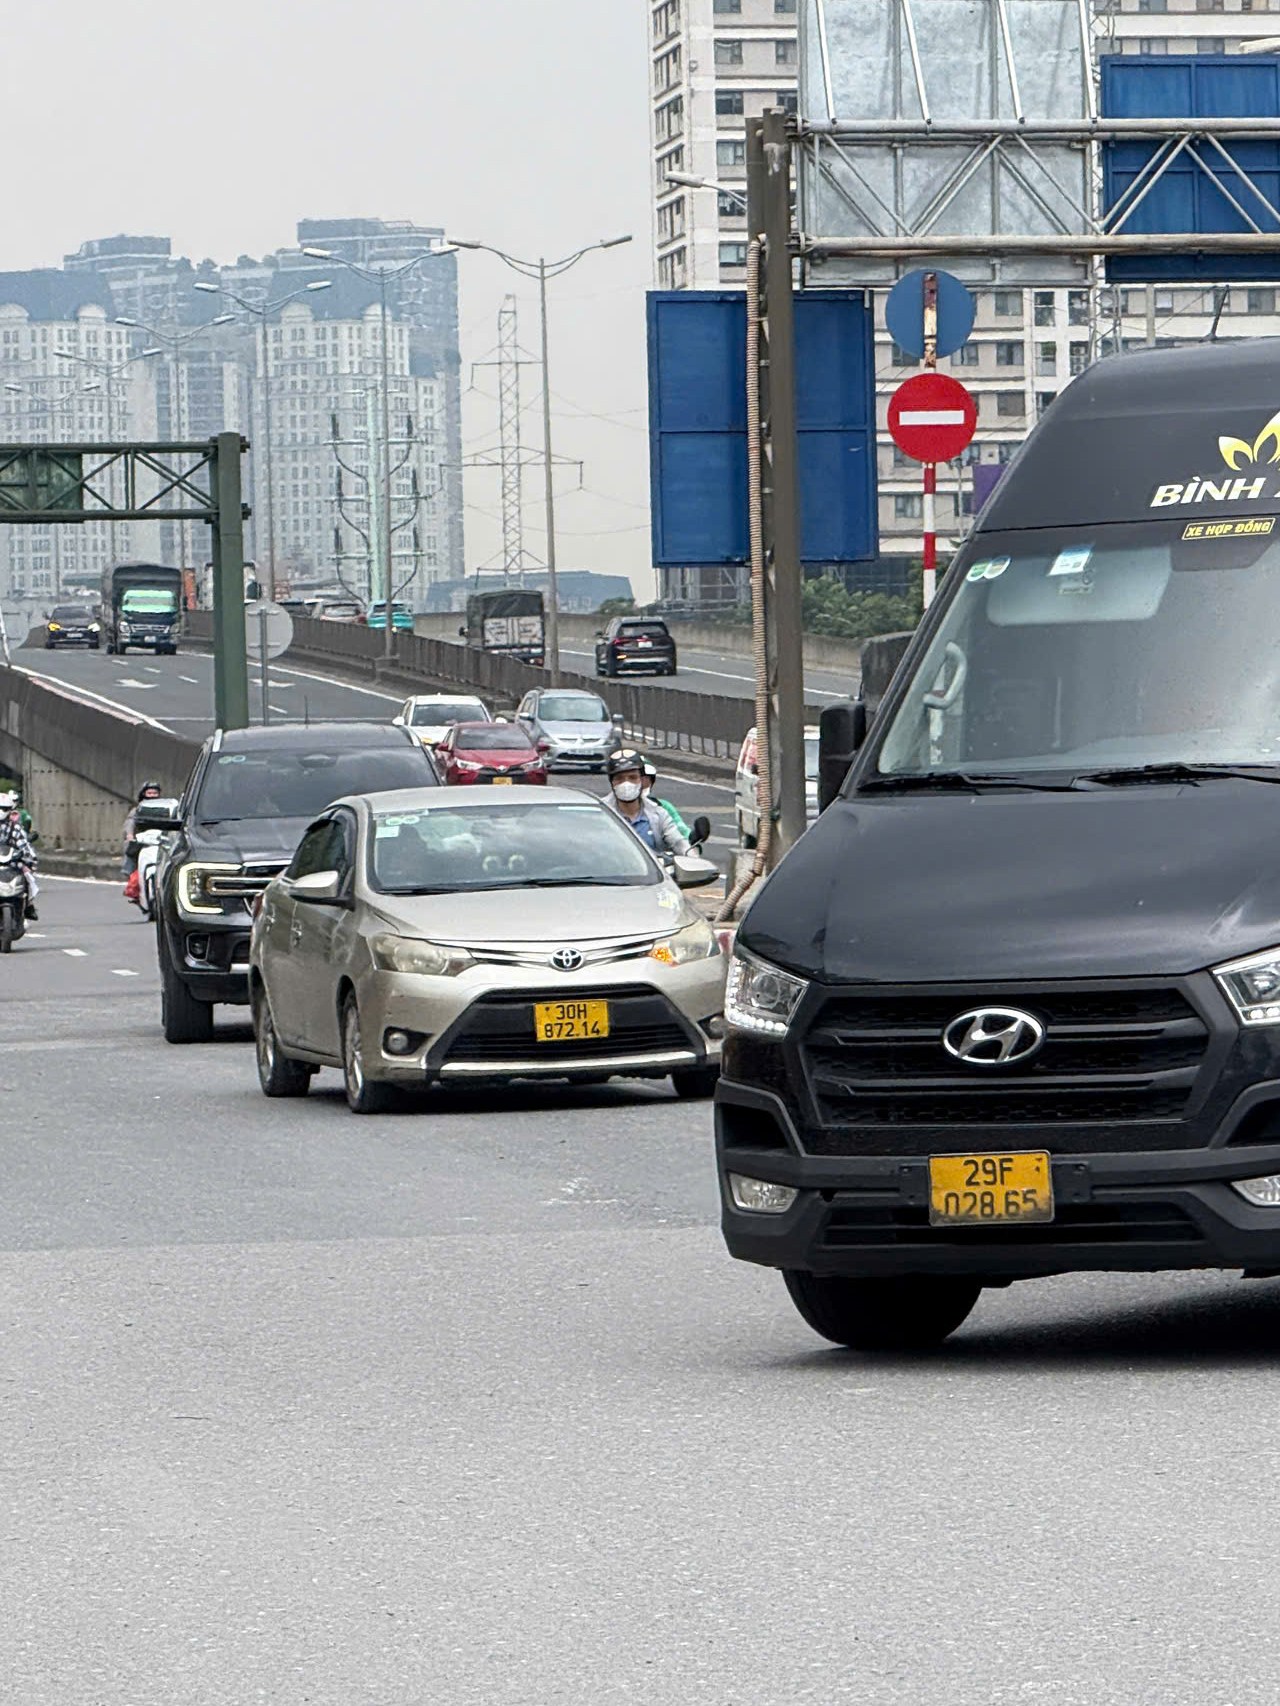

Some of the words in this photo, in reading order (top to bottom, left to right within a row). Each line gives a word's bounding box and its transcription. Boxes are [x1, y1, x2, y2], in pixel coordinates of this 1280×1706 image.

[1150, 476, 1267, 508] BÌNH
[1186, 526, 1205, 537] XE
[1205, 523, 1234, 536] HỢP
[555, 1004, 588, 1020] 30H
[544, 1020, 601, 1038] 872.14
[963, 1157, 1014, 1187] 29F
